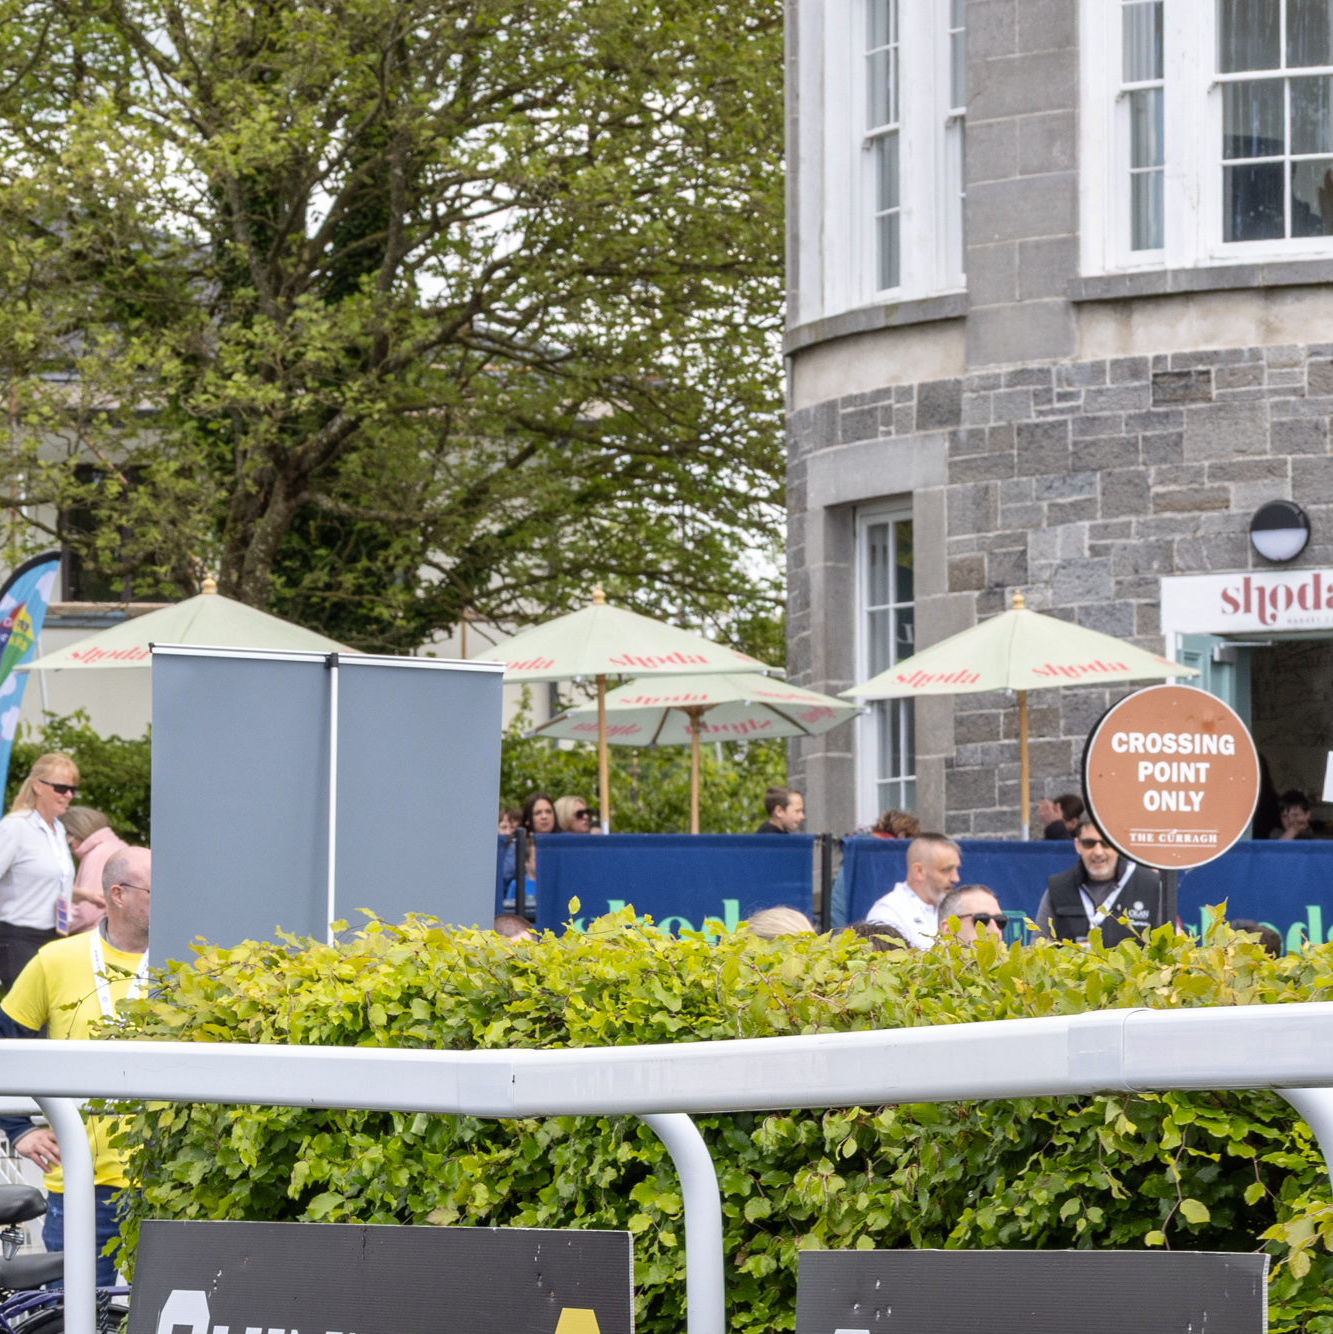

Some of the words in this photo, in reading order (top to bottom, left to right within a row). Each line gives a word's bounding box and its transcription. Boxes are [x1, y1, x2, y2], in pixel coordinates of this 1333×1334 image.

[891, 669, 981, 688] shoda
[1031, 660, 1130, 679] shoda
[1111, 732, 1235, 755] CROSSING
[1138, 761, 1210, 783] POINT
[1143, 790, 1204, 812] ONLY
[1130, 833, 1154, 842] THE
[1159, 833, 1217, 843] CURRAGH
